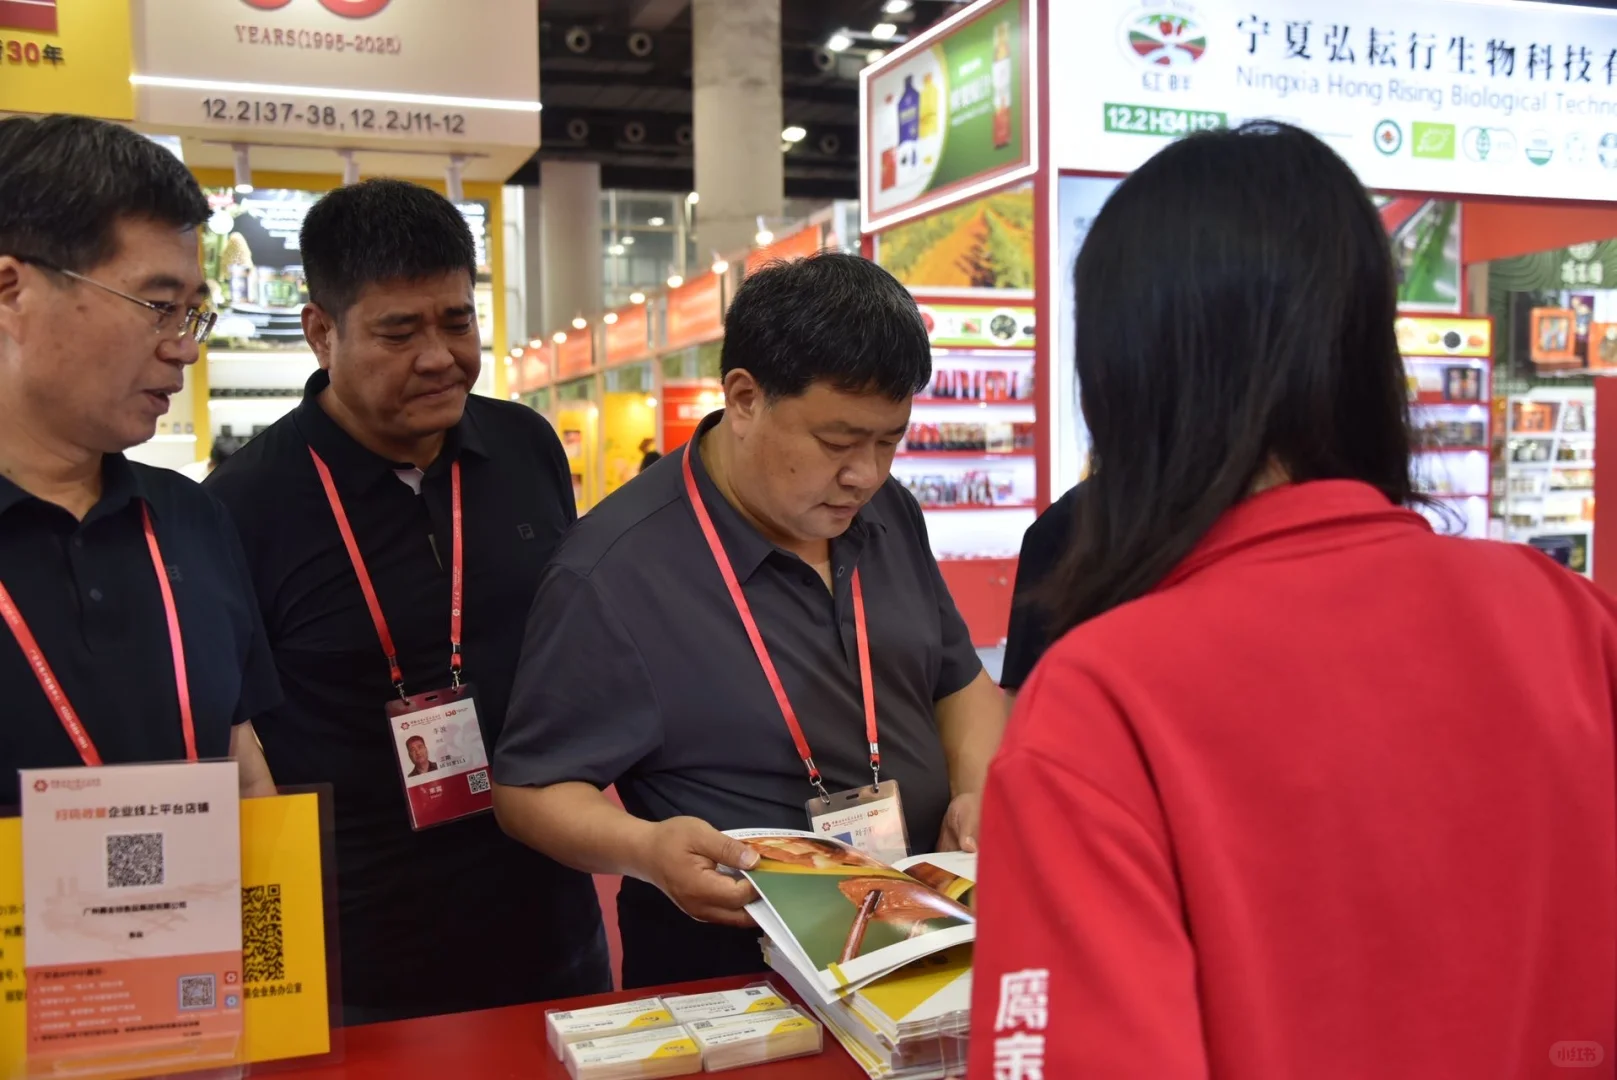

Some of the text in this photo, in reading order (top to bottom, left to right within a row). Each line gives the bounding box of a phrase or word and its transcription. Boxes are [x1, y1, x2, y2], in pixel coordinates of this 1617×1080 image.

[0, 40, 66, 67] 30年
[235, 24, 402, 54] YEARS(1995-2025)
[1237, 66, 1319, 98] Ningxia
[1328, 73, 1382, 101] Hong
[1388, 80, 1443, 109] Rising
[1452, 84, 1549, 113] Biological
[350, 106, 464, 134] 12.2J11-12
